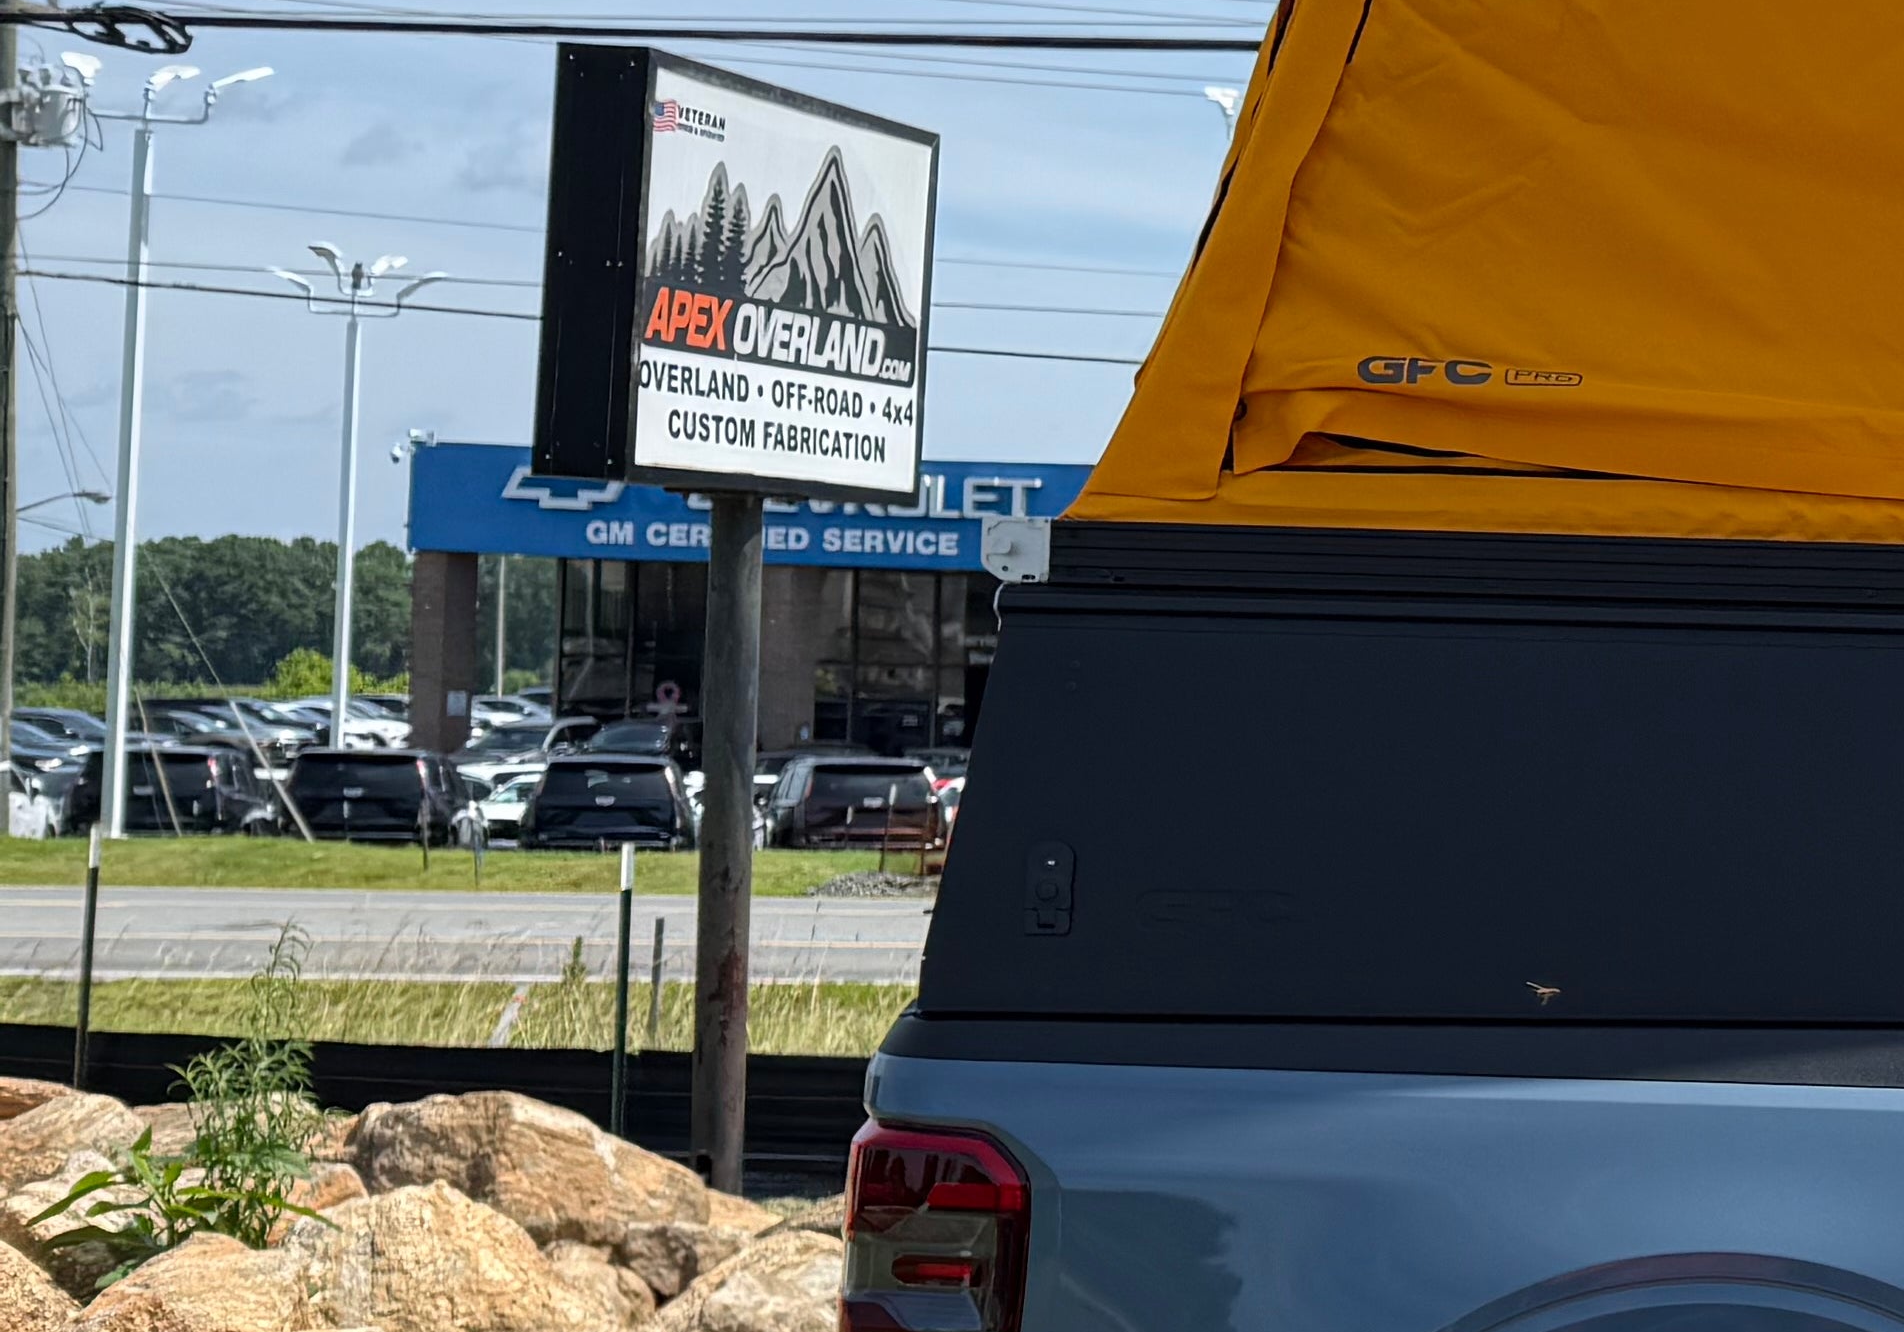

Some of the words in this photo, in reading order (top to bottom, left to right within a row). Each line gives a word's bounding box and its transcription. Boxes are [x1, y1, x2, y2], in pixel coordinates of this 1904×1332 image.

[678, 104, 726, 131] VETERAN
[644, 287, 733, 351] APEX
[640, 360, 749, 403] OVERLAND
[771, 380, 863, 419] OFF-ROAD
[882, 396, 914, 427] 4x4
[1357, 356, 1493, 385] GFC
[1512, 369, 1577, 384] PRO
[668, 409, 755, 448] CUSTOM
[763, 422, 886, 464] FABRICATION
[586, 519, 634, 546] GM
[646, 521, 810, 551] CERED
[822, 526, 959, 556] SERVICE
